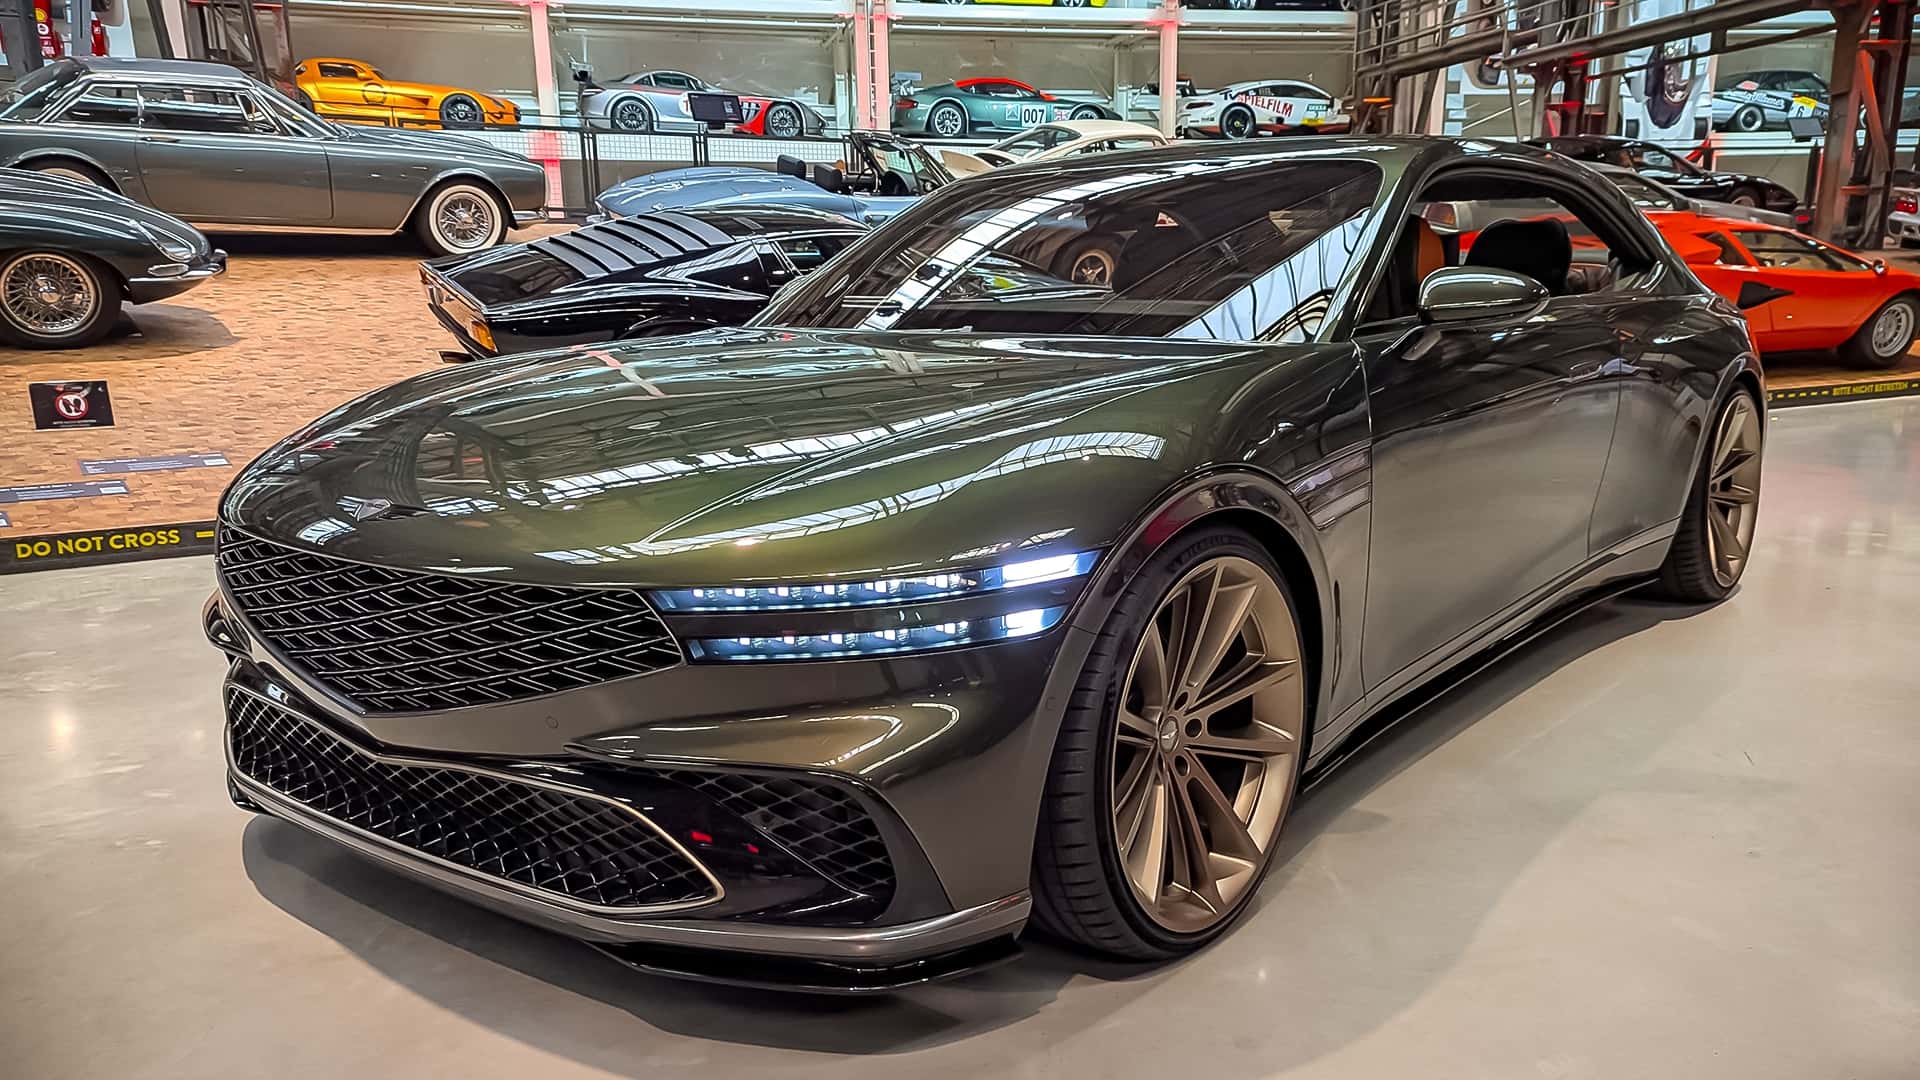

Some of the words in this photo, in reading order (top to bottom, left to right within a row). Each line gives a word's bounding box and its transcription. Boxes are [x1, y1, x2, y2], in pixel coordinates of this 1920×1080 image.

[1024, 109, 1045, 123] 007
[16, 541, 51, 559] DO
[57, 536, 104, 555] NOT
[109, 529, 181, 550] CROSS
